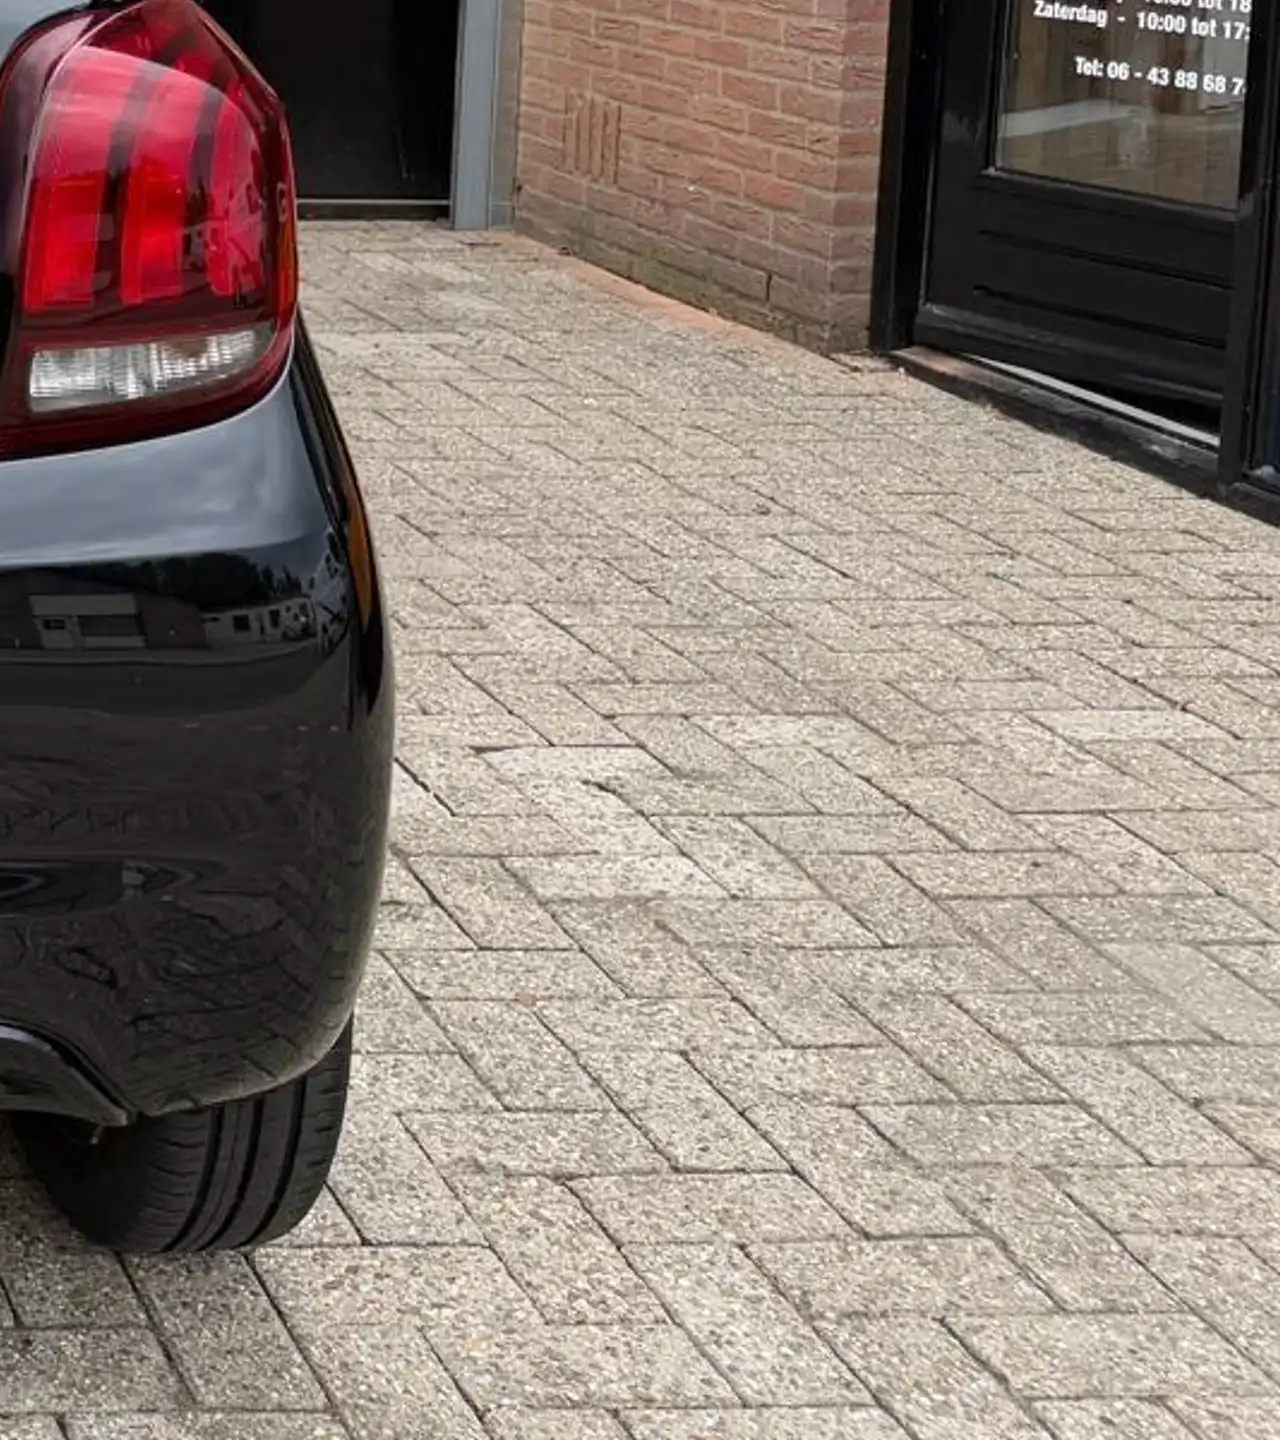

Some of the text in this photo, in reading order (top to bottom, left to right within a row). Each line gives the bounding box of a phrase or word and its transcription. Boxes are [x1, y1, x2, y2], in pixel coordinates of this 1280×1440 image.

[1033, 0, 1108, 28] Zaterdag
[1137, 11, 1187, 34] 10:00
[1190, 15, 1218, 38] tot
[1075, 56, 1103, 78] Tel:
[1106, 61, 1131, 81] 06
[1147, 66, 1170, 86] 43
[1174, 69, 1198, 90] 88
[1203, 72, 1227, 93] 68
